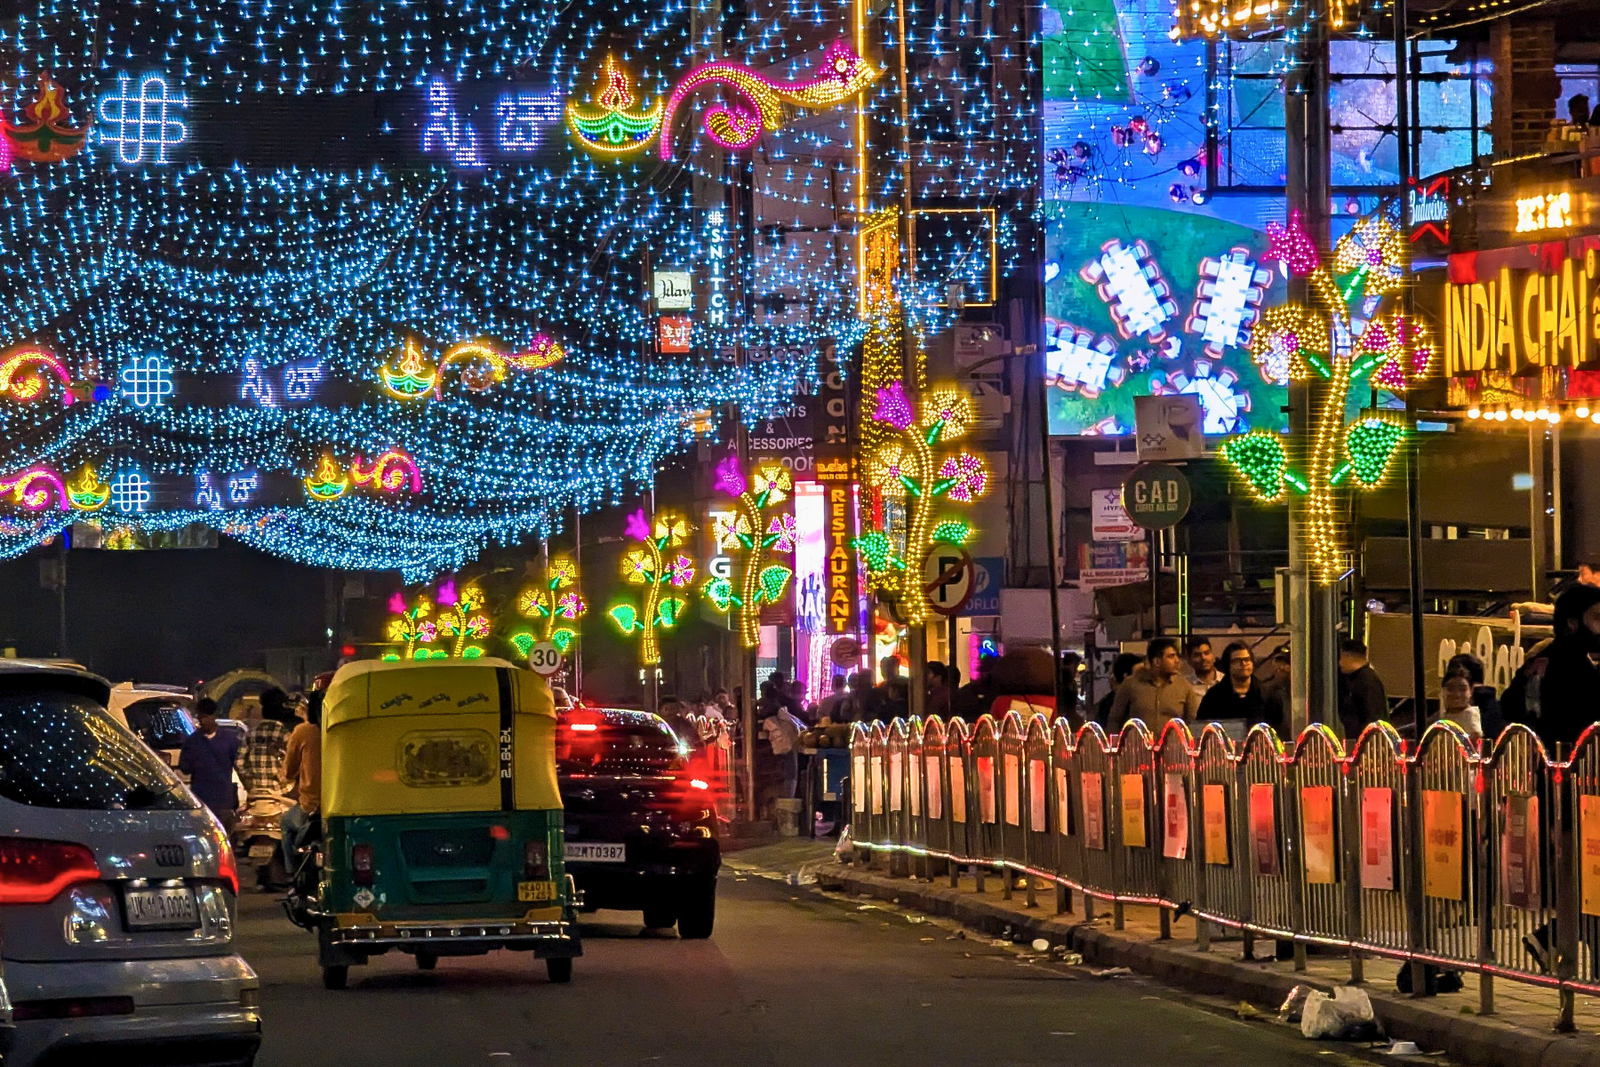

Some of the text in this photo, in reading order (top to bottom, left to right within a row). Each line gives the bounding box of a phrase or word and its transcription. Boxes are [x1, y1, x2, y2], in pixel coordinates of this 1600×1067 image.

[710, 228, 724, 324] SNITCH
[1445, 258, 1587, 377] INDIA CHAI
[727, 437, 813, 450] ACESSORIES
[1135, 480, 1179, 504] CAD
[830, 489, 849, 632] RESTAURANT
[965, 597, 999, 610] ORLD
[533, 649, 558, 667] 30
